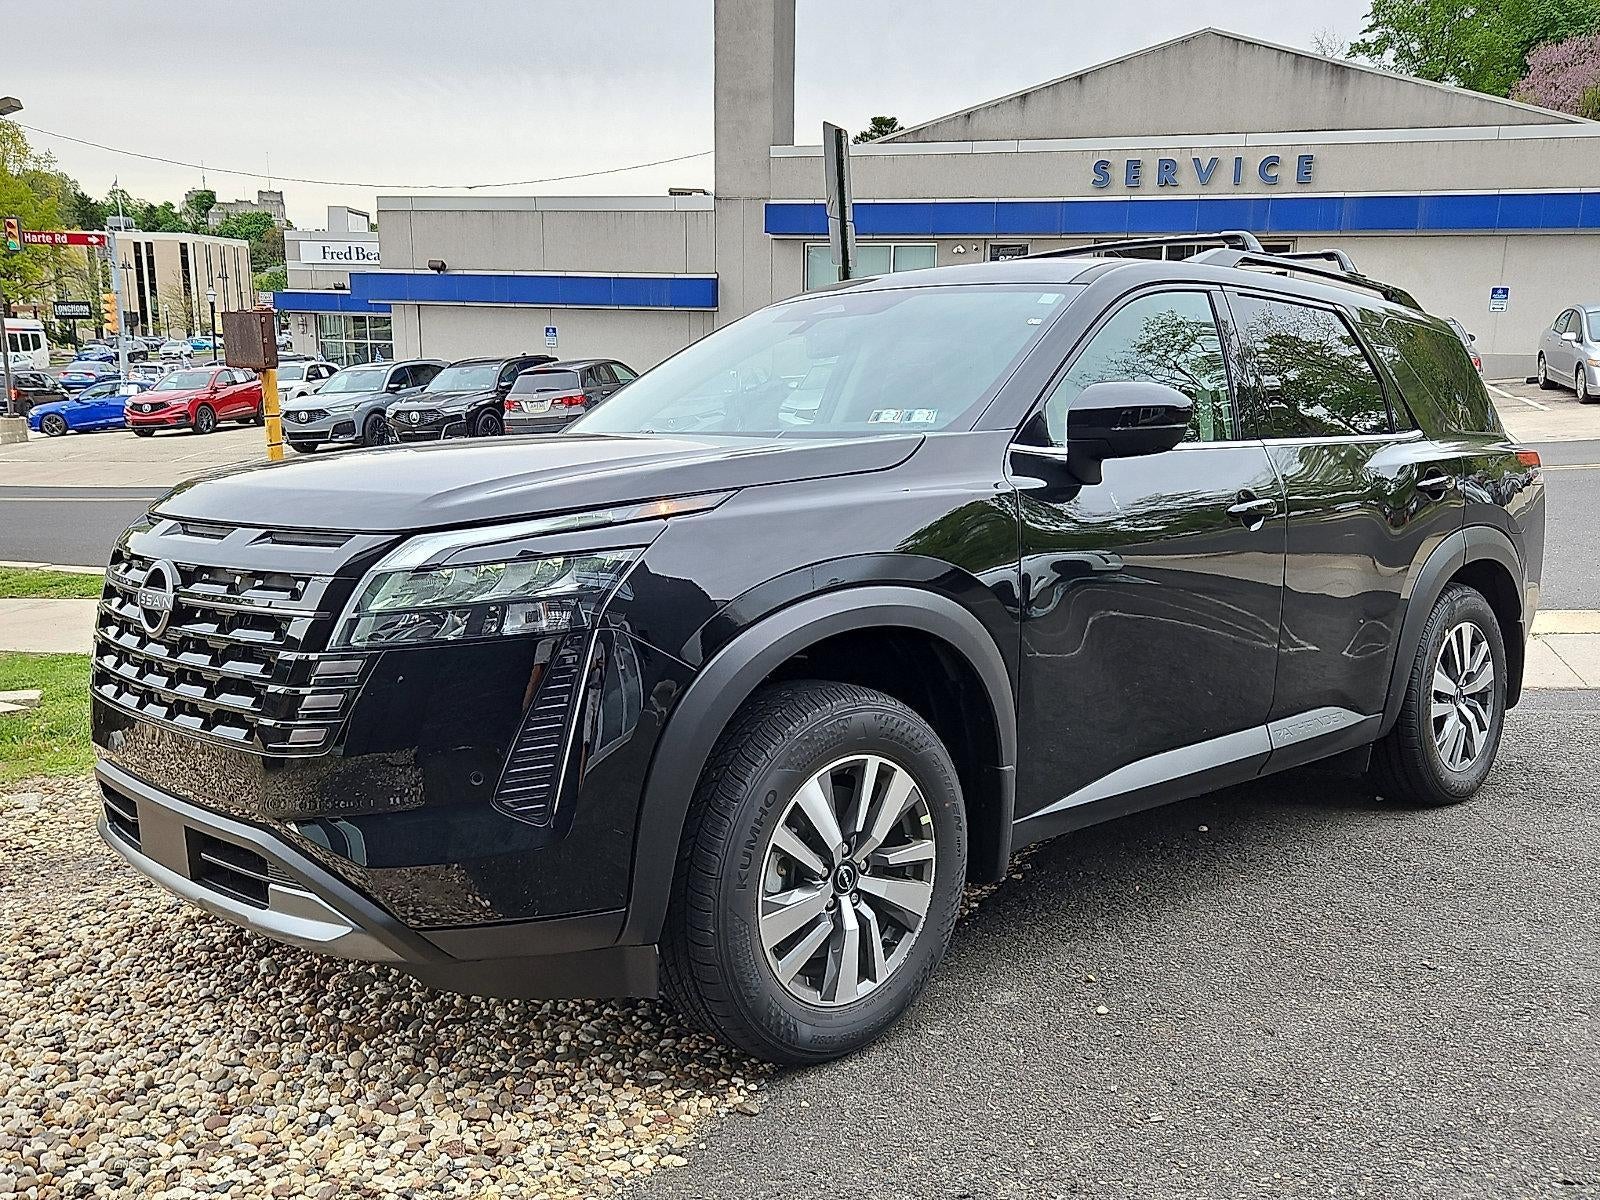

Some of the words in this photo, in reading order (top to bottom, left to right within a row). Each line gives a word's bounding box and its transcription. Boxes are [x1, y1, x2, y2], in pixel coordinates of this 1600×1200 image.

[1091, 154, 1315, 188] SERVICE
[24, 232, 53, 244] Harte
[55, 233, 68, 244] Rd
[321, 245, 353, 261] Fred
[355, 246, 380, 261] Bea
[54, 304, 90, 313] LONGHORN
[1273, 711, 1348, 742] PATHFINDER
[735, 789, 778, 890] KUMHO
